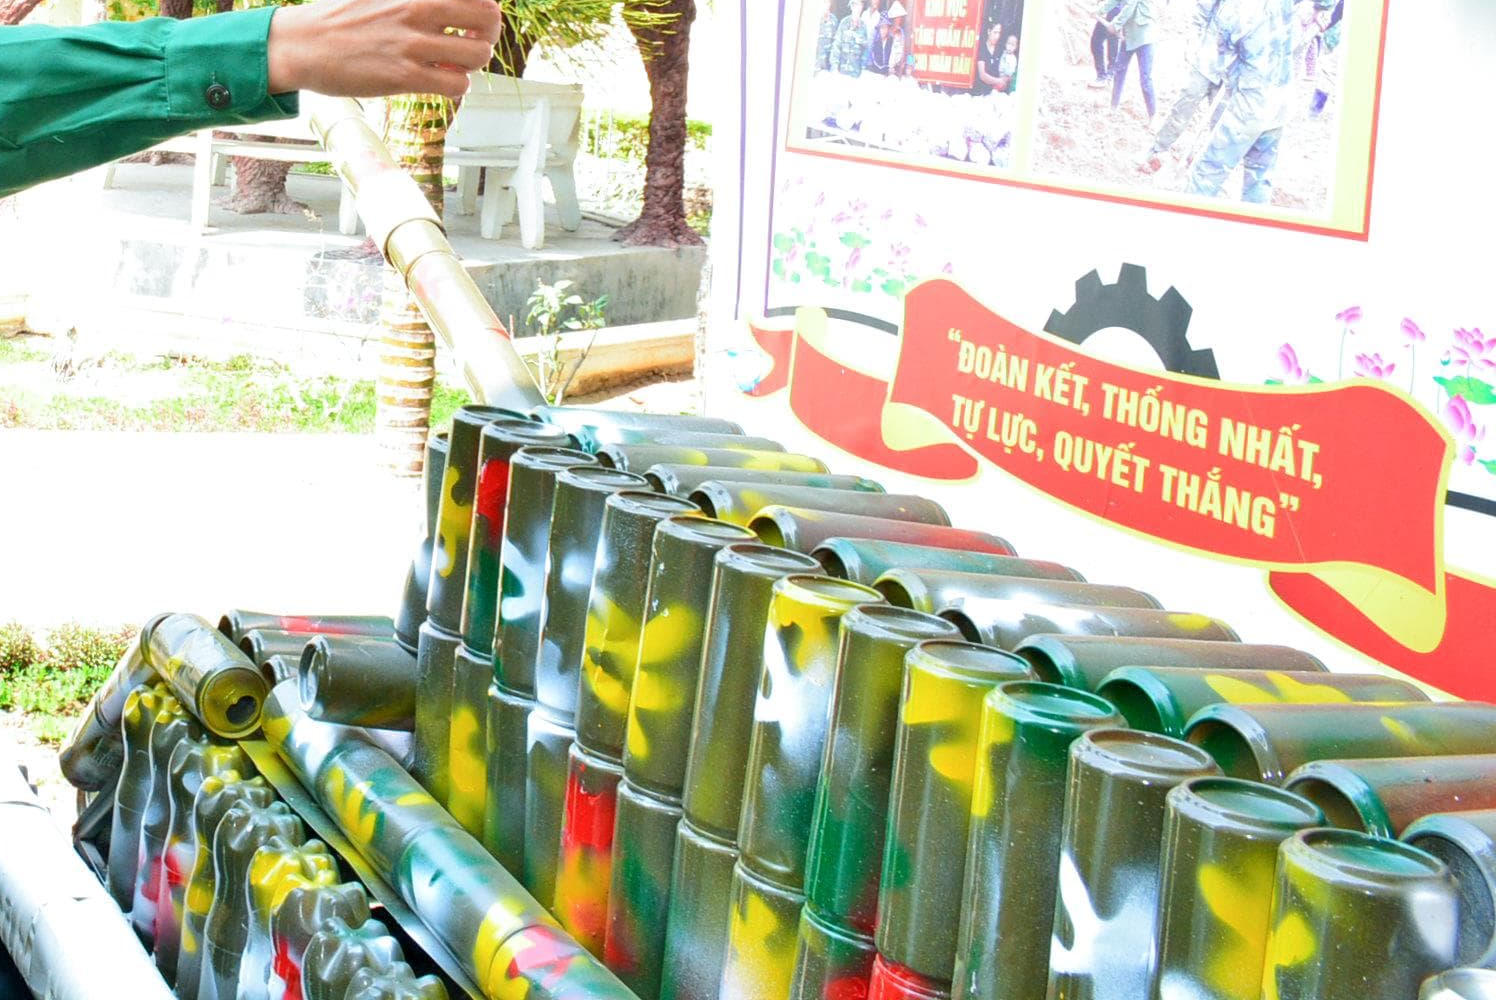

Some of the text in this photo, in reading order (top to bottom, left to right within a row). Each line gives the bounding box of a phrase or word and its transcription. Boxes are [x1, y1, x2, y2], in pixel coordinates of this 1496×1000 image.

[947, 327, 1323, 490] “ĐOÀN KẾT, THỐNG NHẤT,
[951, 393, 1299, 539] TỰ LỰC, QUYẾT THẮNG”
